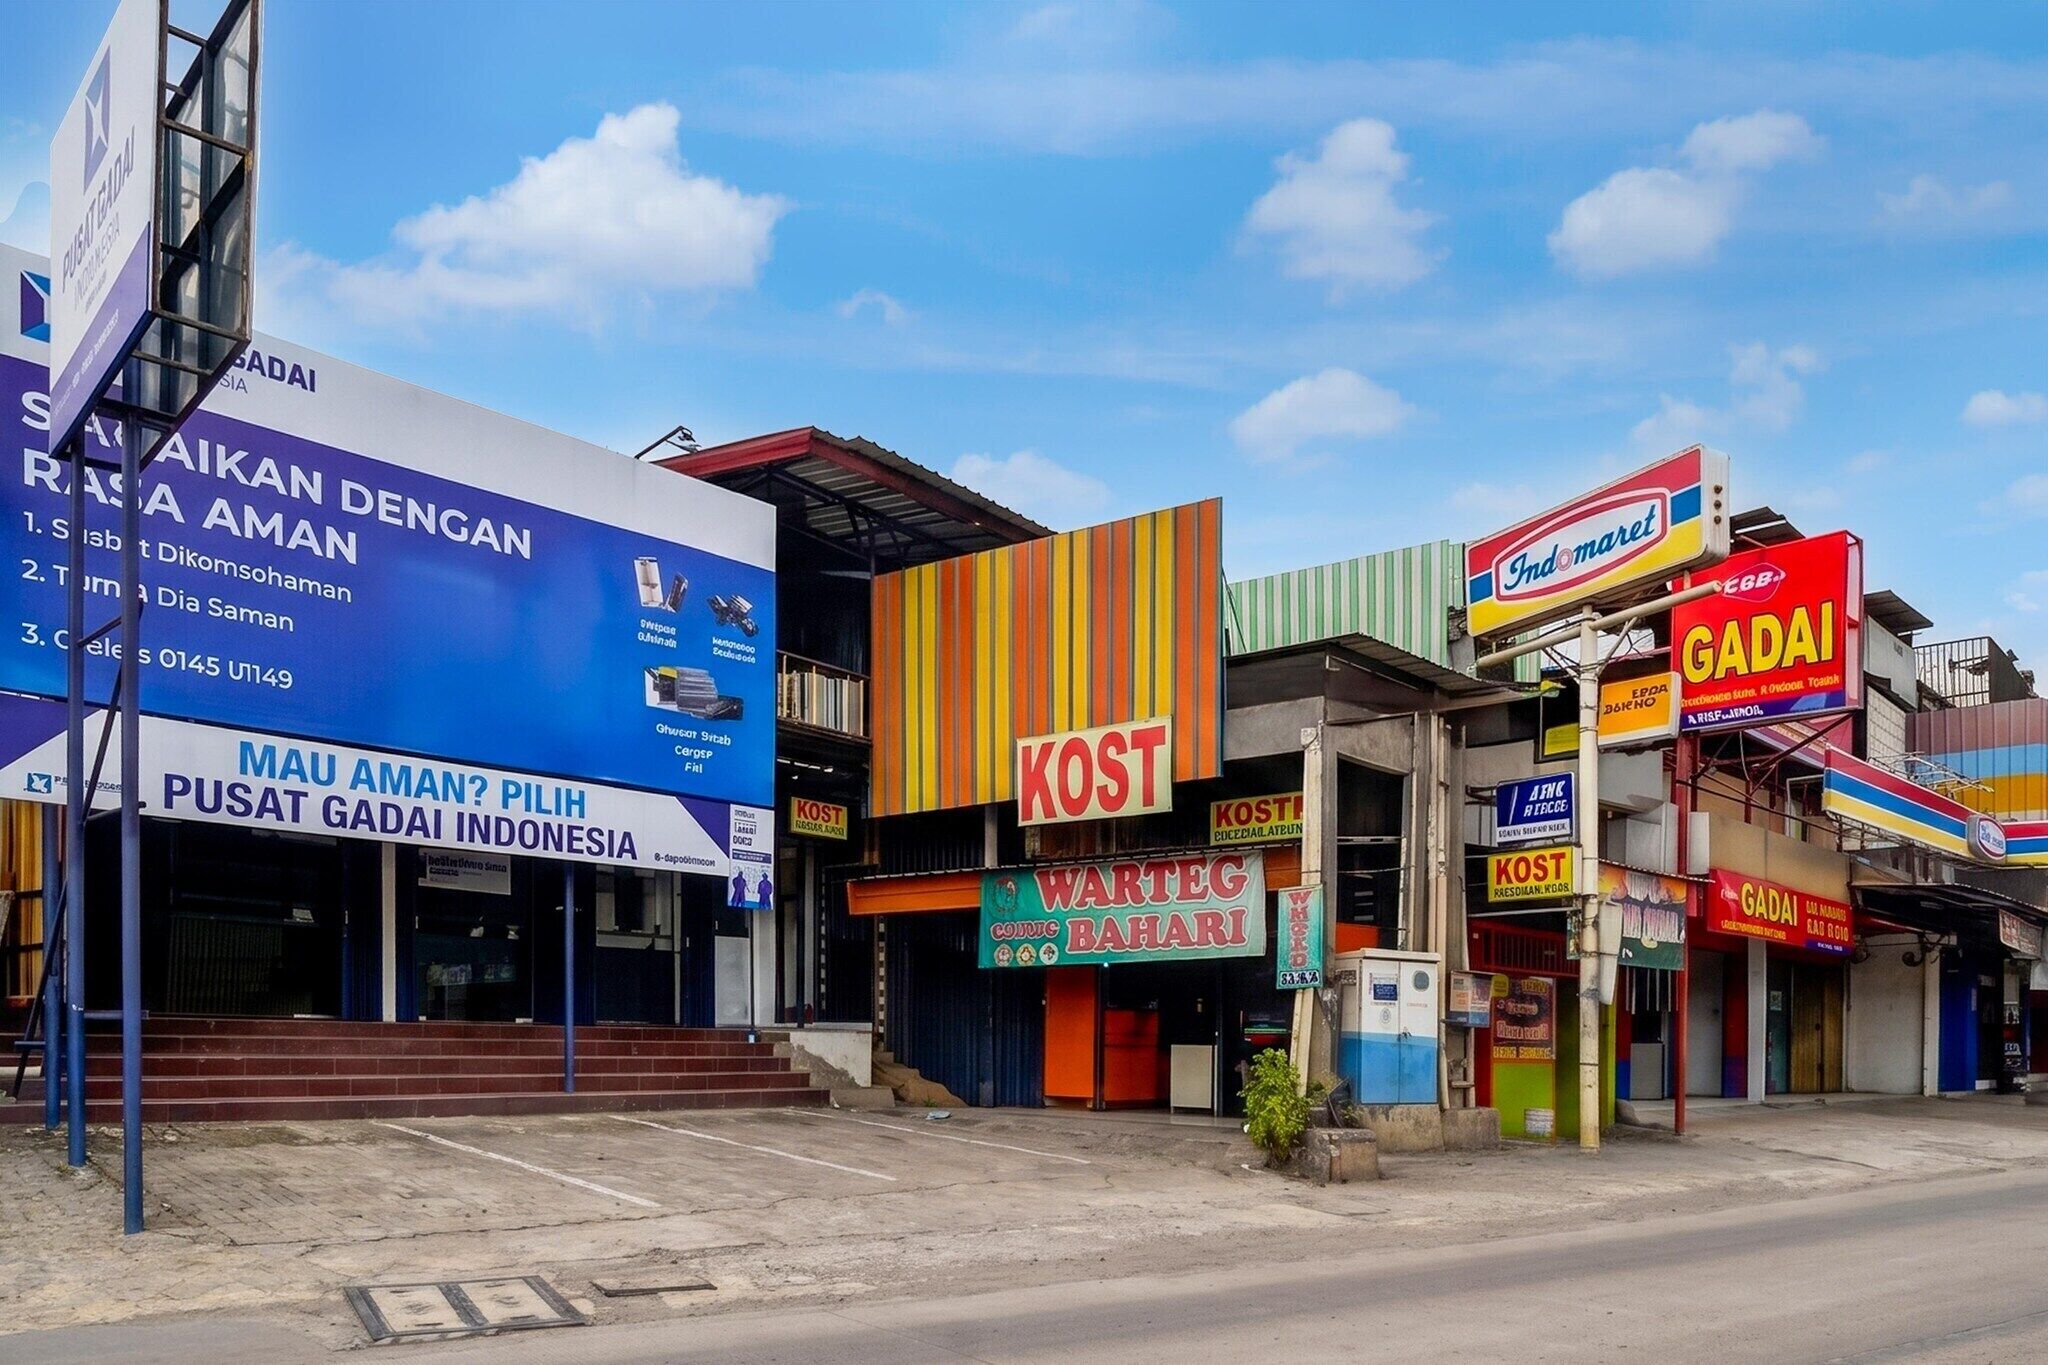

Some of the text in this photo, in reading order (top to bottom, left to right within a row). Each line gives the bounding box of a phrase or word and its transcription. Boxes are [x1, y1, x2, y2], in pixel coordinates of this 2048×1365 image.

[62, 197, 97, 294] PUSAT
[97, 123, 136, 231] GADAI
[202, 497, 358, 565] AMAN
[341, 477, 532, 560] DENGAN
[1503, 504, 1657, 591] Indomaret
[21, 559, 46, 583] 2.
[157, 586, 201, 613] Dia
[207, 597, 295, 632] Saman
[23, 511, 43, 534] 1.
[157, 541, 353, 604] Dikomsohaman
[21, 622, 46, 647] 3.
[1681, 600, 1836, 685] GADAI
[239, 740, 587, 819] MAU AMAN? PILIH
[1021, 725, 1167, 822] KOST
[163, 772, 638, 861] PUSAT GADAI INDONESIA
[797, 799, 843, 825] KOST
[1035, 854, 1249, 912] WARTEG
[1496, 852, 1567, 886] KOST
[1741, 882, 1798, 927] GADAI
[1067, 907, 1248, 953] BAHARI
